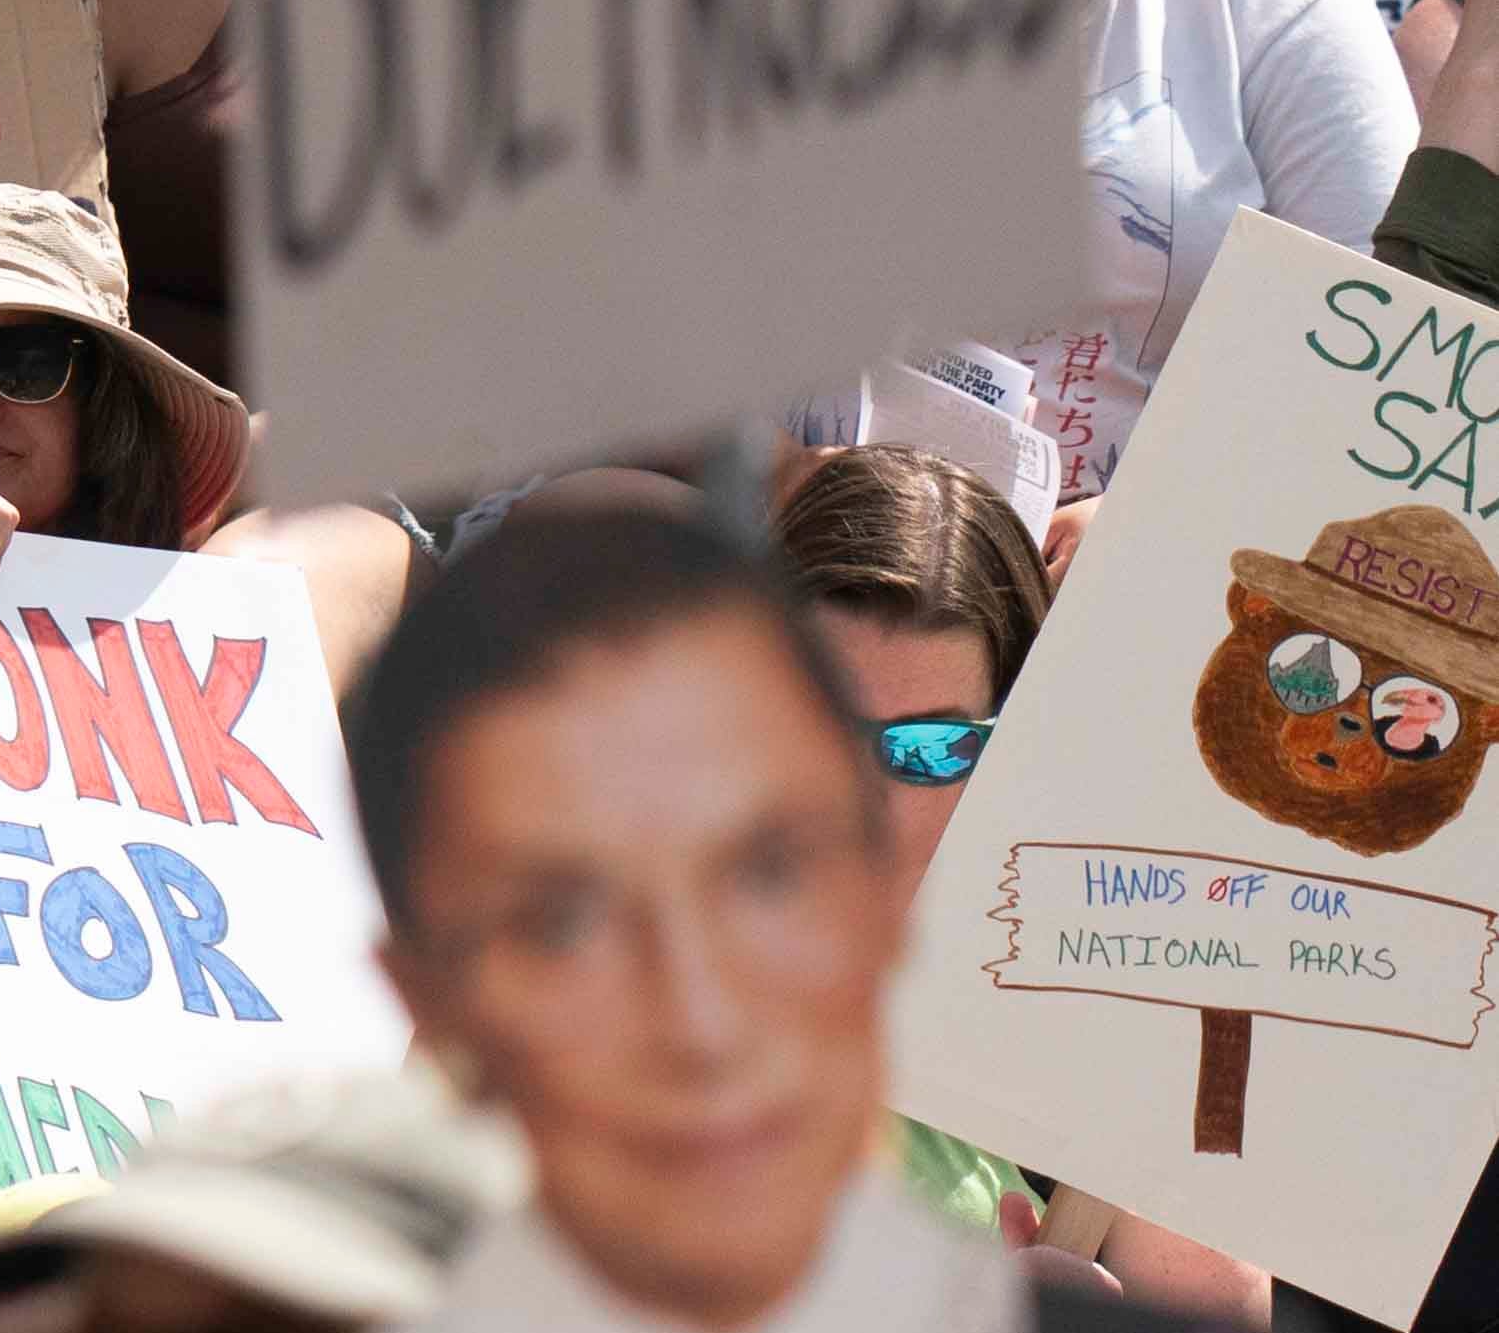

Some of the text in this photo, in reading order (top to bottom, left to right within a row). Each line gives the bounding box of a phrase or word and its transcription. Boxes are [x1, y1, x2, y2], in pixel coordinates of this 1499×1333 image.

[963, 373, 1007, 400] PARTY
[1347, 389, 1499, 519] SA
[1335, 535, 1494, 627] RESIST
[1084, 858, 1352, 920] HANDS OFF OUR
[1056, 927, 1397, 982] NATIONAL PARKS
